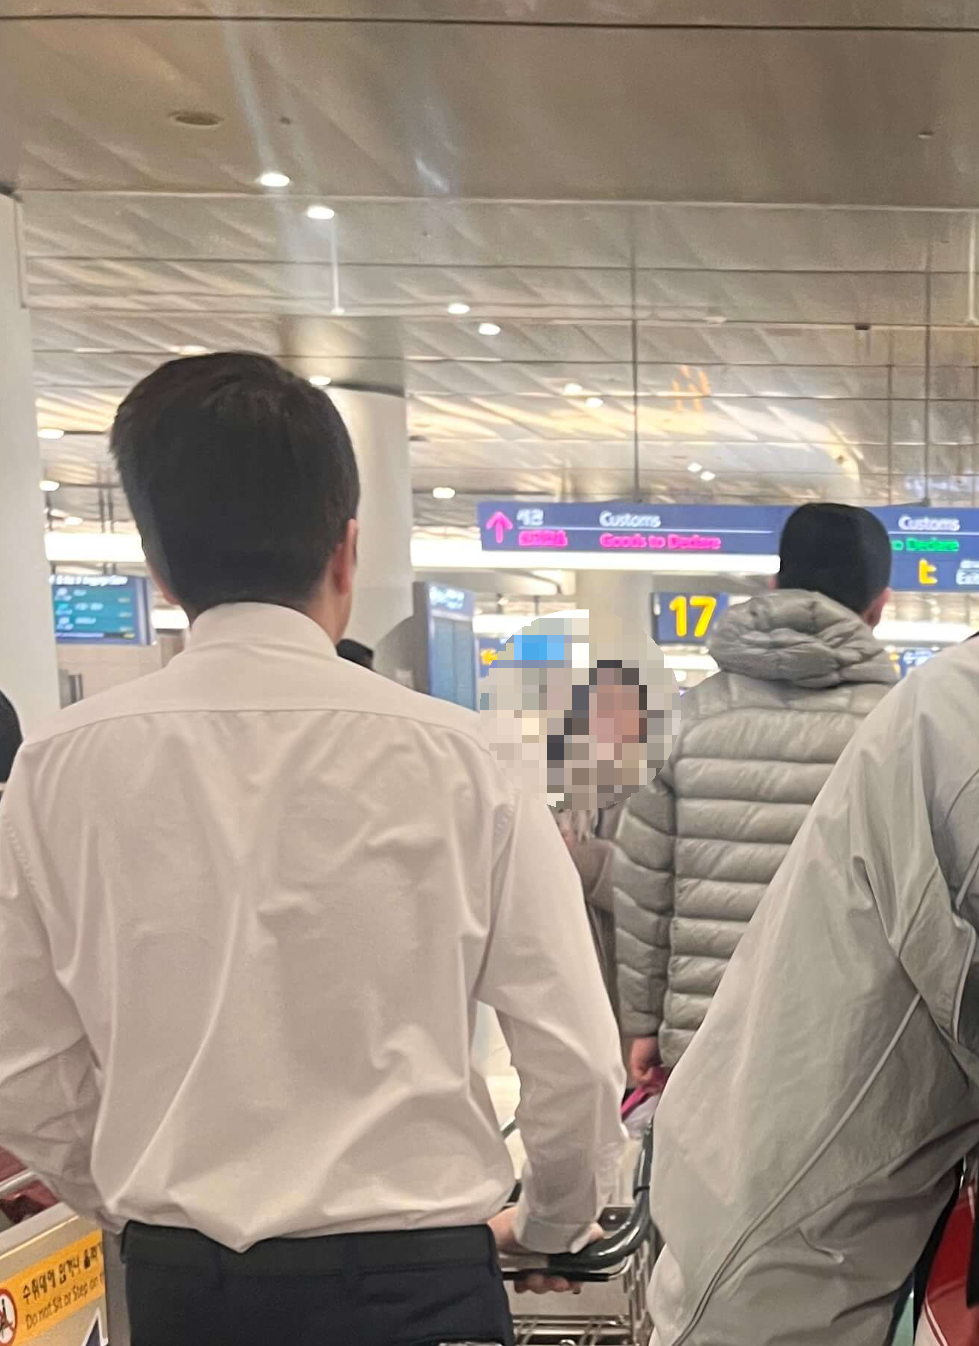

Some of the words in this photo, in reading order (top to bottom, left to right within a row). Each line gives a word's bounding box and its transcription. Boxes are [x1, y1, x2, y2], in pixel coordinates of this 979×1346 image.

[600, 511, 661, 527] Customs
[899, 514, 960, 531] Customs
[601, 533, 647, 548] Goods
[669, 596, 716, 637] 17
[26, 1313, 38, 1330] Do
[72, 1283, 88, 1302] Step
